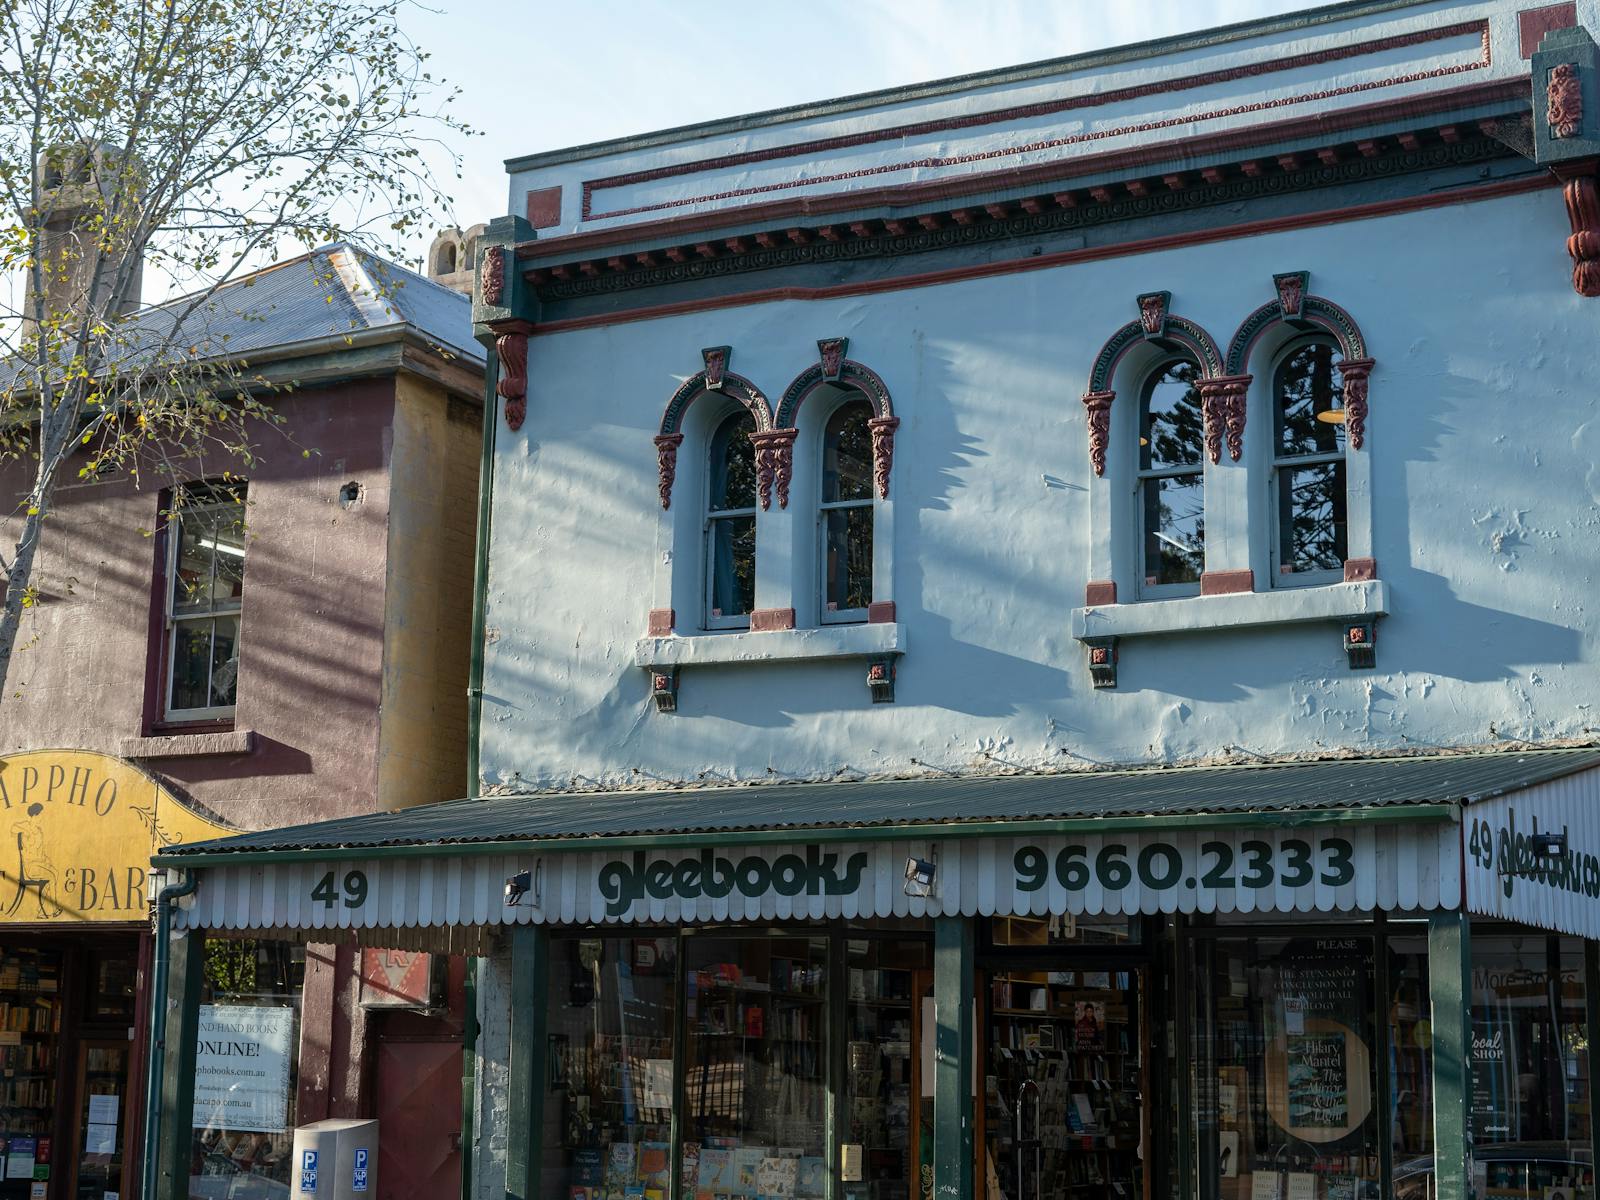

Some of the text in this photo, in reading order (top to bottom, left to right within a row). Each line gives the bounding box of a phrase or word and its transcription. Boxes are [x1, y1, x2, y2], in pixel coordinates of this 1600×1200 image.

[1470, 818, 1493, 871] 49
[1013, 838, 1355, 891] 9660.2333
[79, 866, 145, 911] BAR
[311, 870, 368, 909] 49
[598, 845, 867, 917] gleebooks
[1048, 912, 1076, 938] 49
[1316, 940, 1358, 950] PLEASE
[1475, 968, 1514, 991] More
[1328, 991, 1353, 999] HALL
[246, 1024, 278, 1034] BOOKS
[1305, 1040, 1338, 1056] Hilary
[1473, 1049, 1504, 1060] SHOP
[1299, 1054, 1341, 1068] Mantel
[196, 1066, 265, 1077] phobooks.com.au
[1322, 1069, 1342, 1082] The
[304, 1152, 316, 1169] P
[356, 1151, 366, 1168] P
